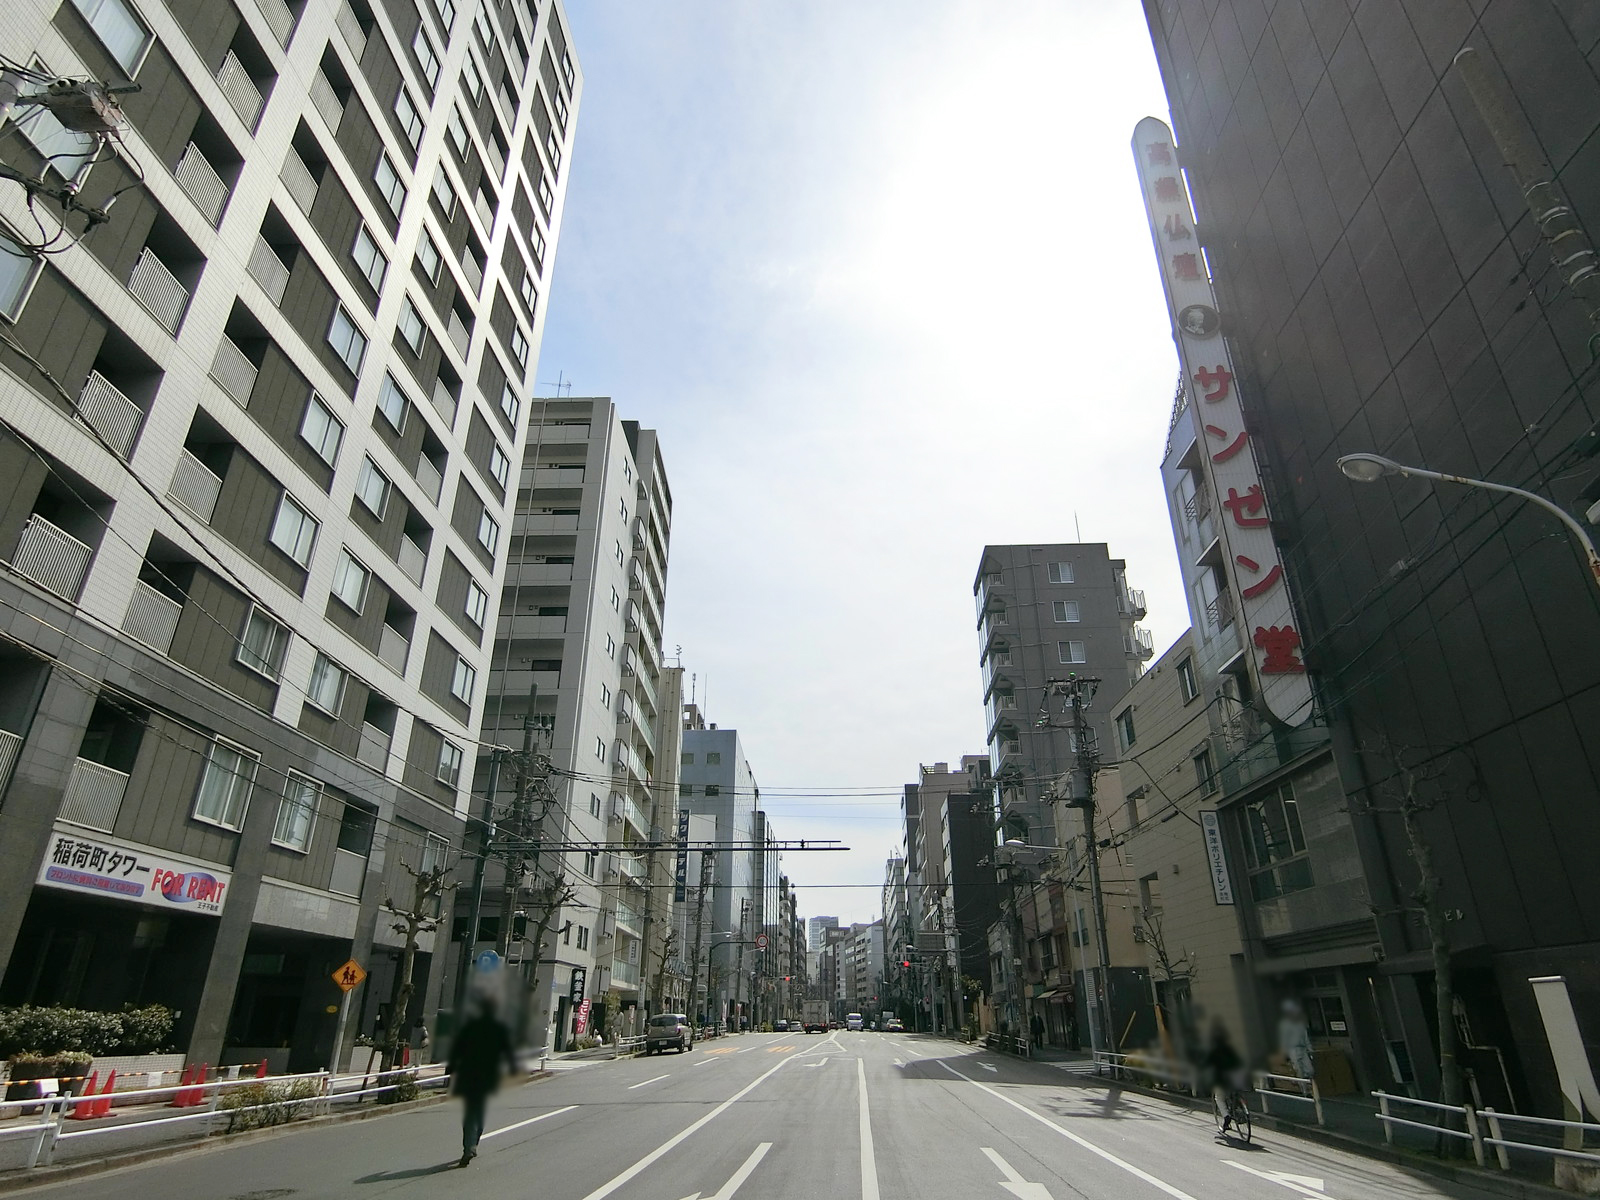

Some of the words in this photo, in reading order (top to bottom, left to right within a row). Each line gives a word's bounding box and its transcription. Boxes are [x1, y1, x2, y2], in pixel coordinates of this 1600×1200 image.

[53, 838, 150, 877] 稲荷町タワー
[151, 868, 186, 897] FOR
[187, 876, 225, 904] RENT
